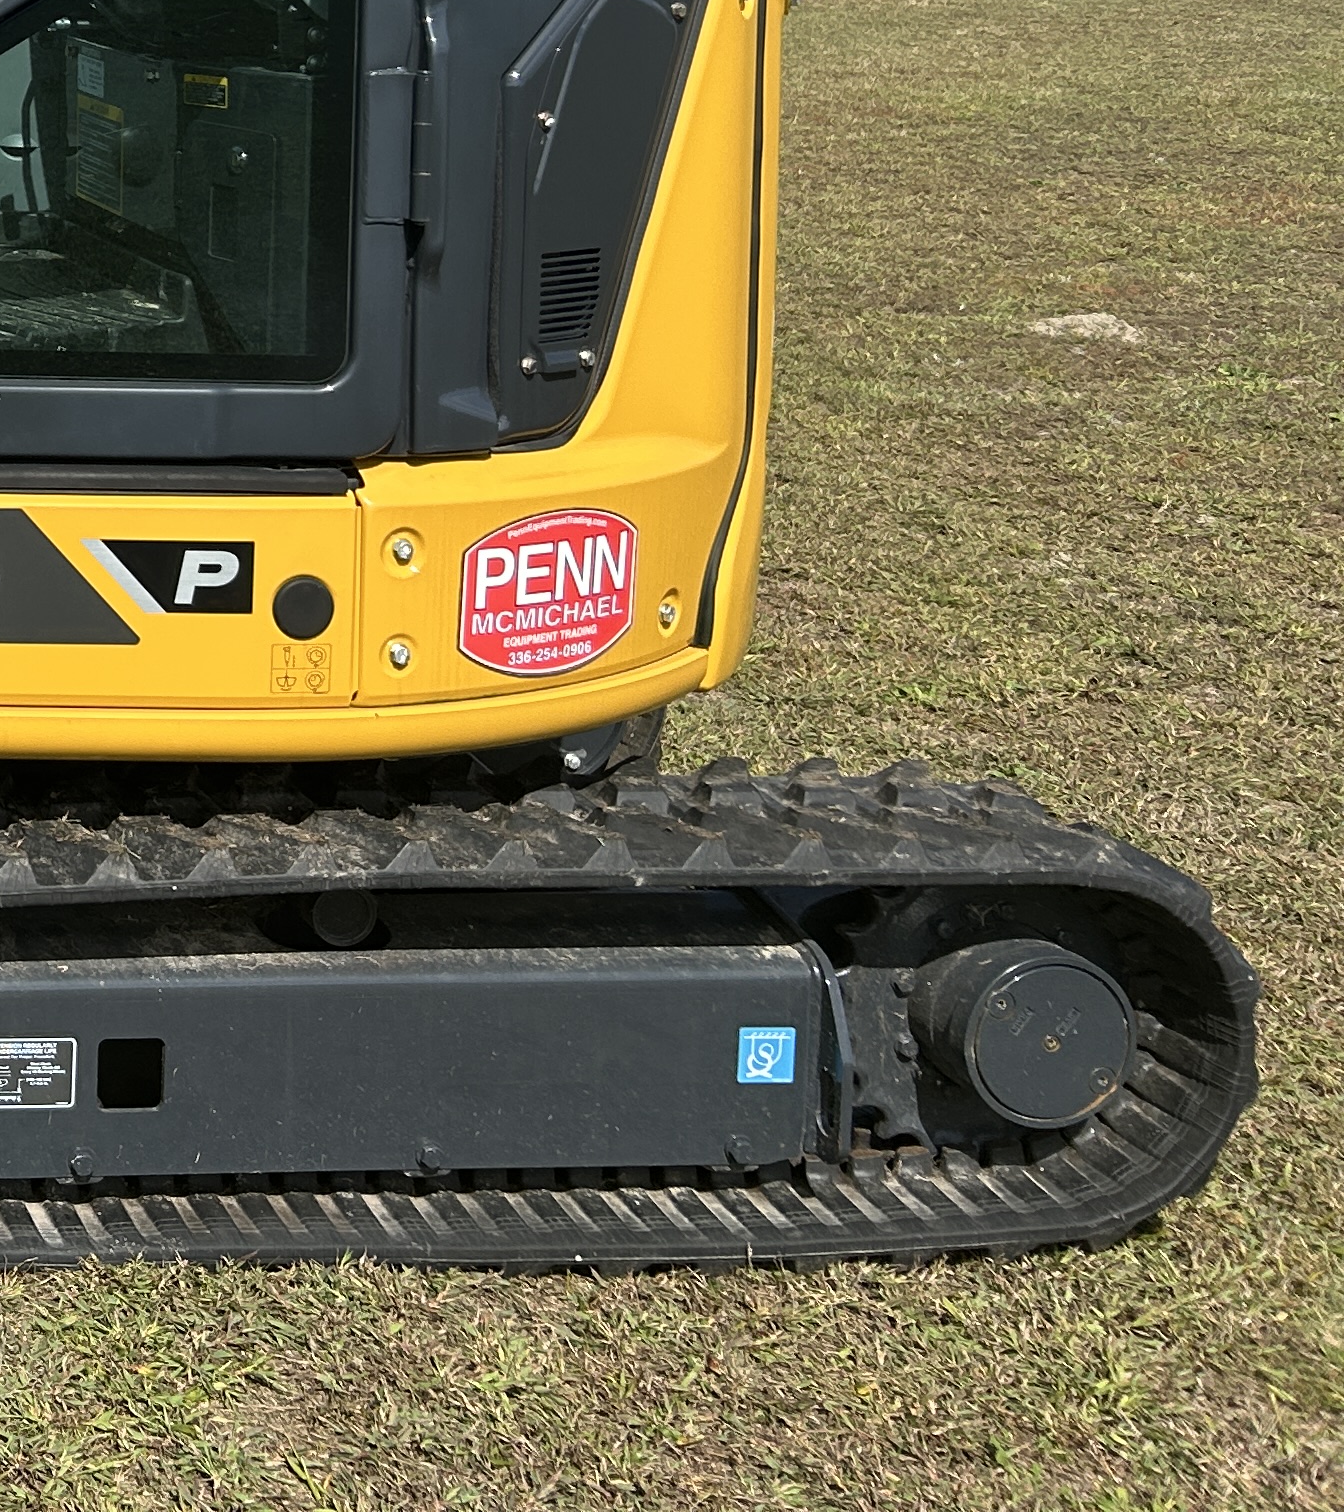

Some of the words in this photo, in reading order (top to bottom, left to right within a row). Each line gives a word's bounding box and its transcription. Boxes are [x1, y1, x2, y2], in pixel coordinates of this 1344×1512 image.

[173, 548, 241, 606] P
[474, 530, 628, 610] PENN
[471, 595, 623, 635] MCMICHAEL
[503, 631, 558, 648] EQUIPMENT
[559, 624, 598, 640] TRADING
[507, 640, 592, 666] 336-254-0906
